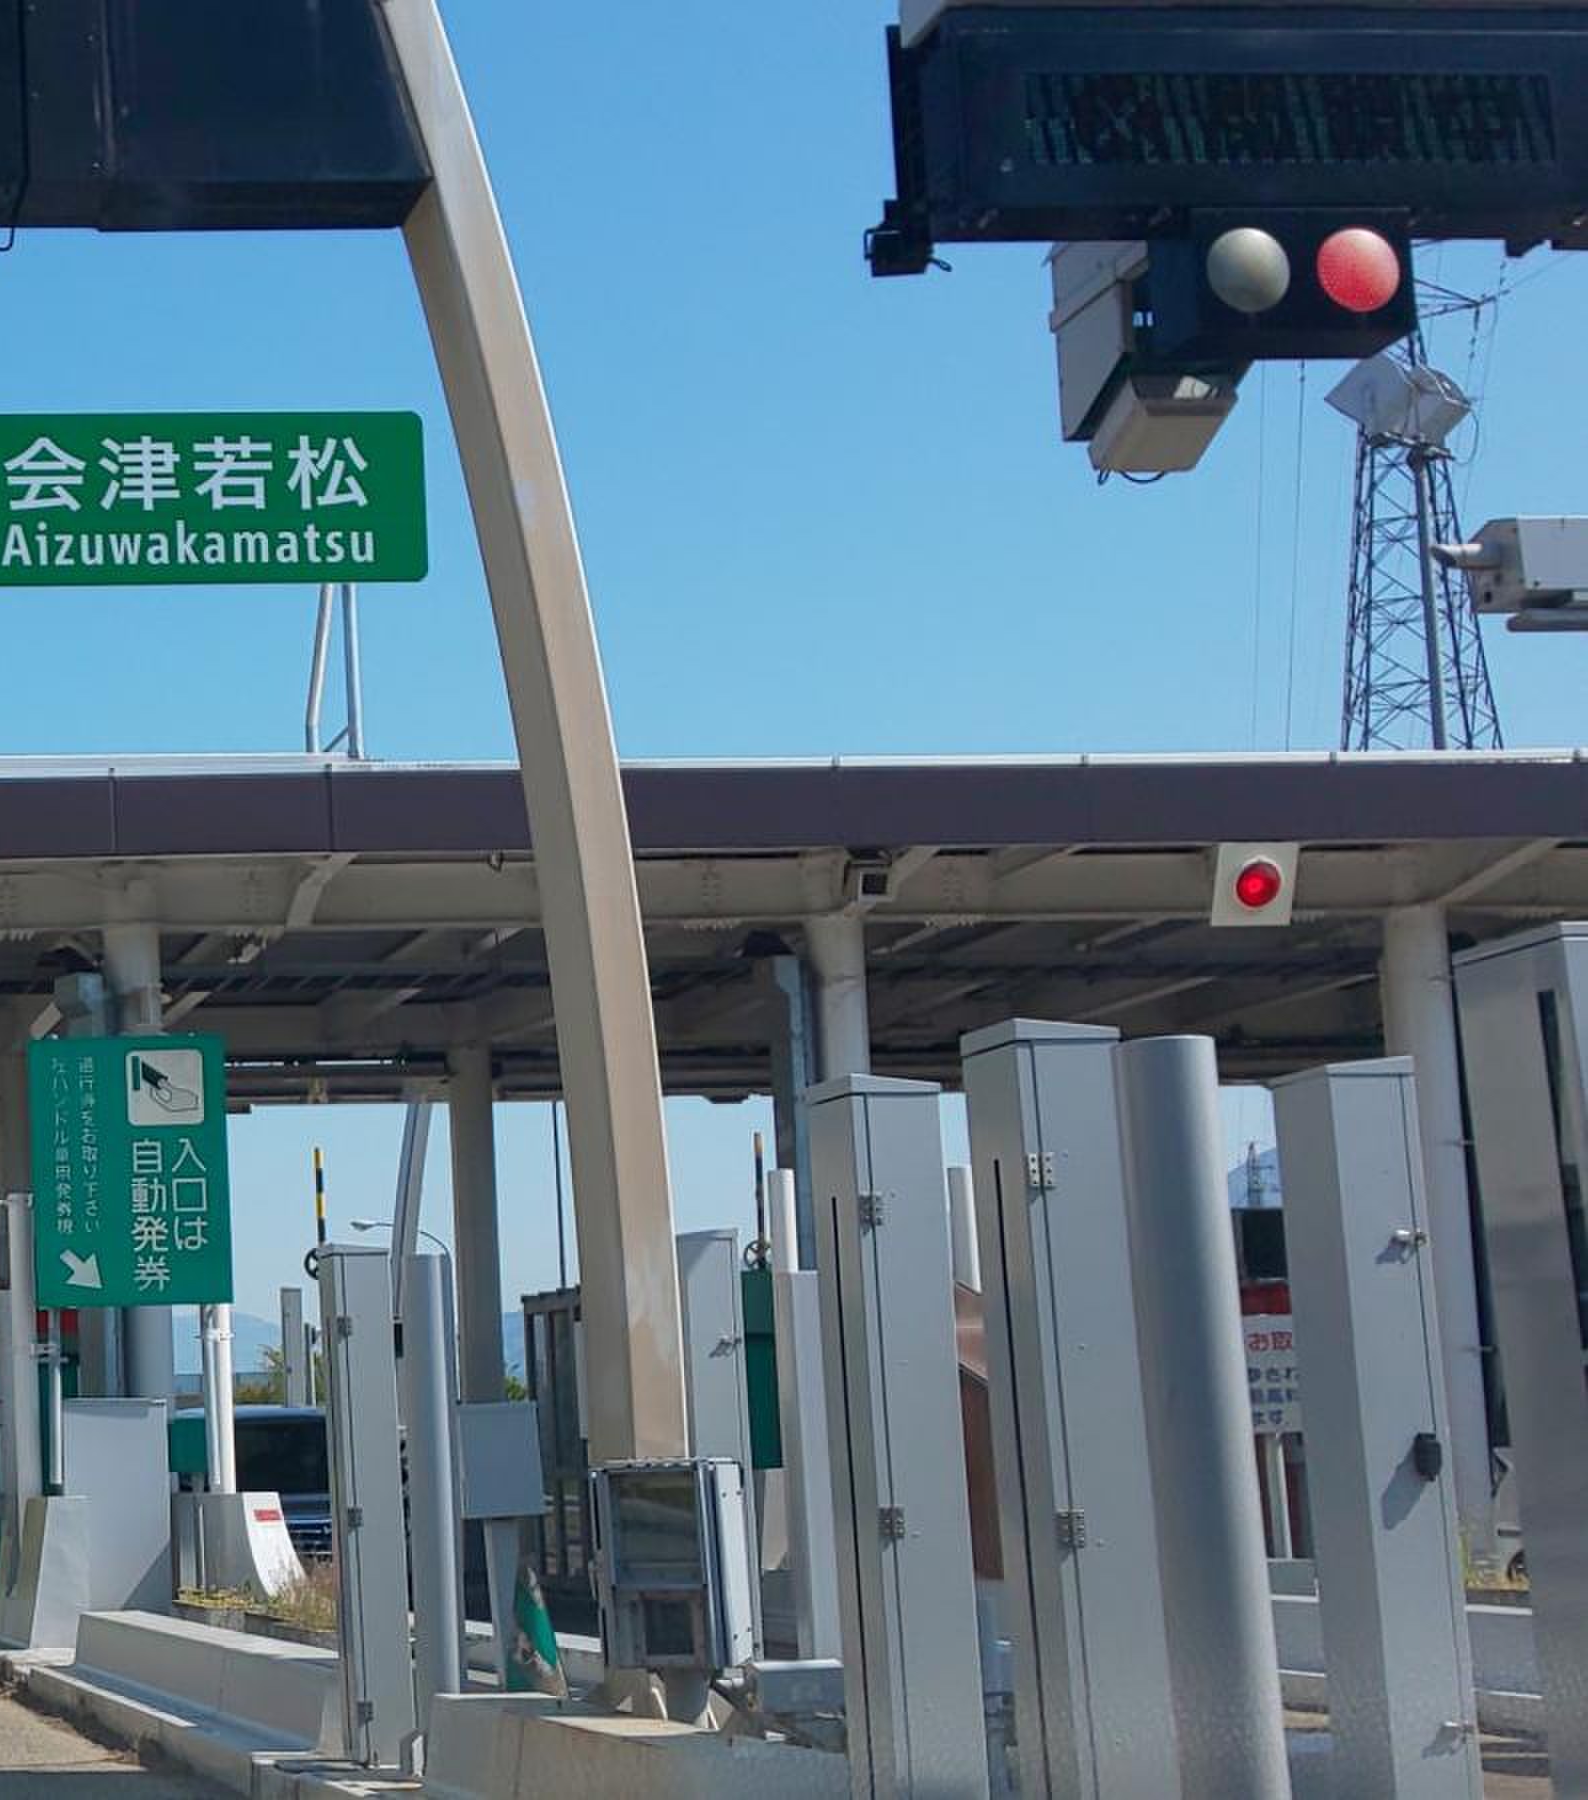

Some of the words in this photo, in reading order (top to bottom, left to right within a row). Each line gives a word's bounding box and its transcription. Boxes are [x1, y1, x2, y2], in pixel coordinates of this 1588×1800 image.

[3, 435, 369, 511] 会津若松
[2, 521, 374, 566] Aizuwakamatsu
[131, 1139, 170, 1291] 自動発券
[172, 1138, 207, 1250] 入口は
